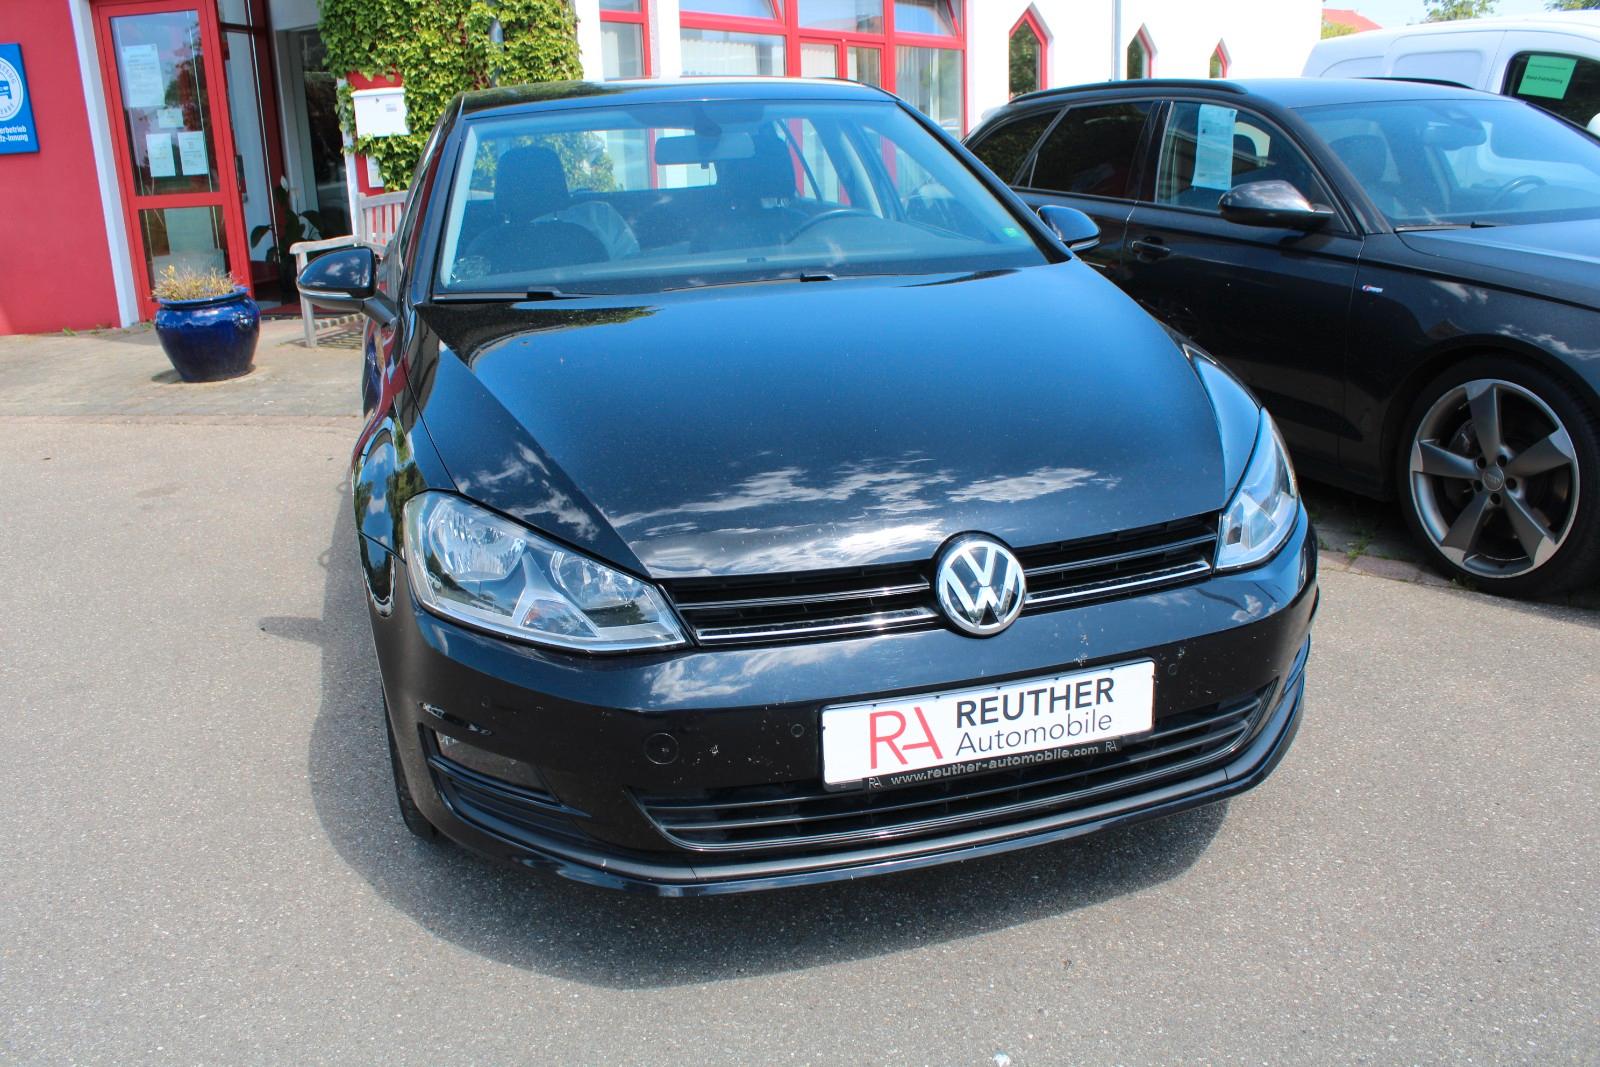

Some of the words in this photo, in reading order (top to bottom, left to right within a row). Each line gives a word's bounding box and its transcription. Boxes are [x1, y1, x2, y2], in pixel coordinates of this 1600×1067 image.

[956, 677, 1115, 729] REUTHER
[869, 706, 943, 770] RA
[955, 709, 1112, 757] Automobile
[890, 745, 1099, 786] www.reuther-automobile.com
